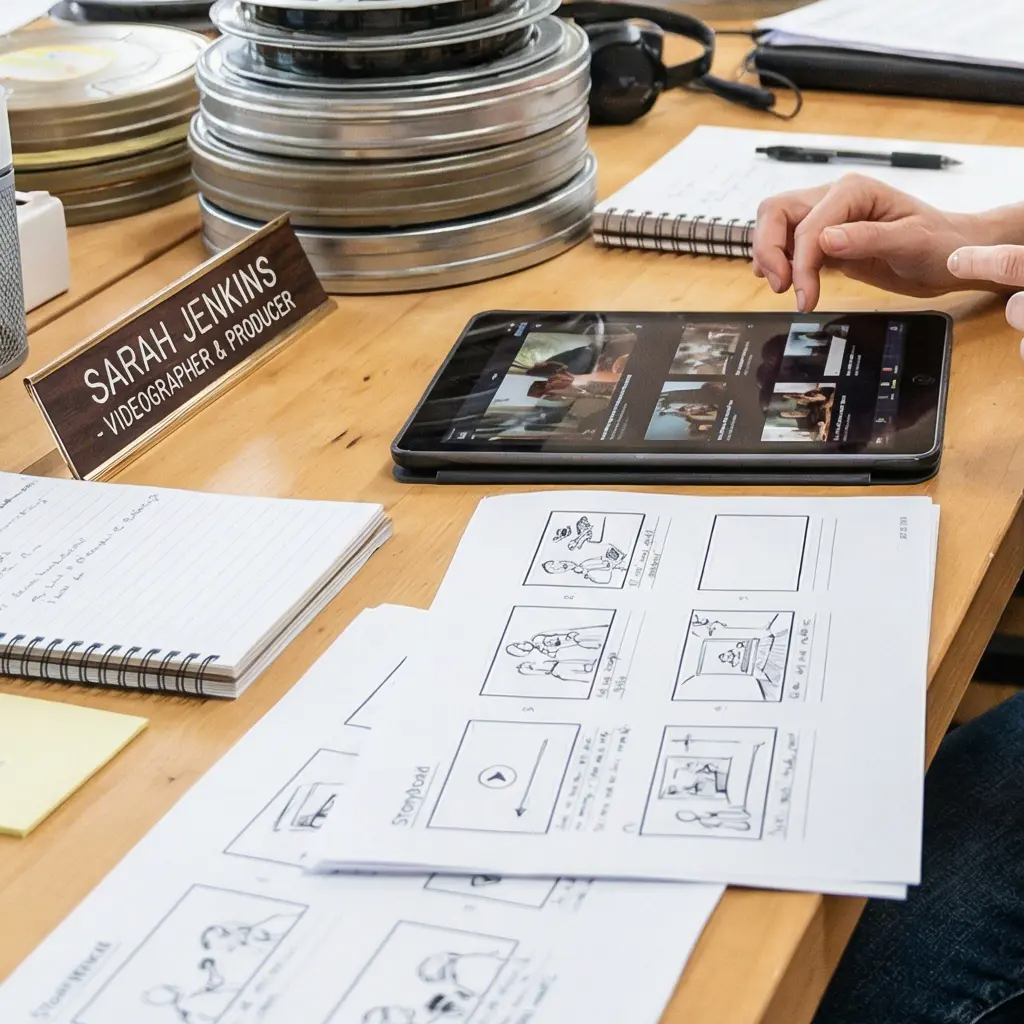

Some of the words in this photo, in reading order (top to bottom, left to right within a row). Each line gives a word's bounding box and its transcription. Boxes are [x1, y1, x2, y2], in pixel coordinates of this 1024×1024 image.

[83, 321, 178, 404] SARAH
[180, 255, 277, 343] JENKINS
[103, 347, 215, 436] VIDEOGRAPHER
[214, 339, 228, 360] &
[225, 290, 297, 352] PRODUCER
